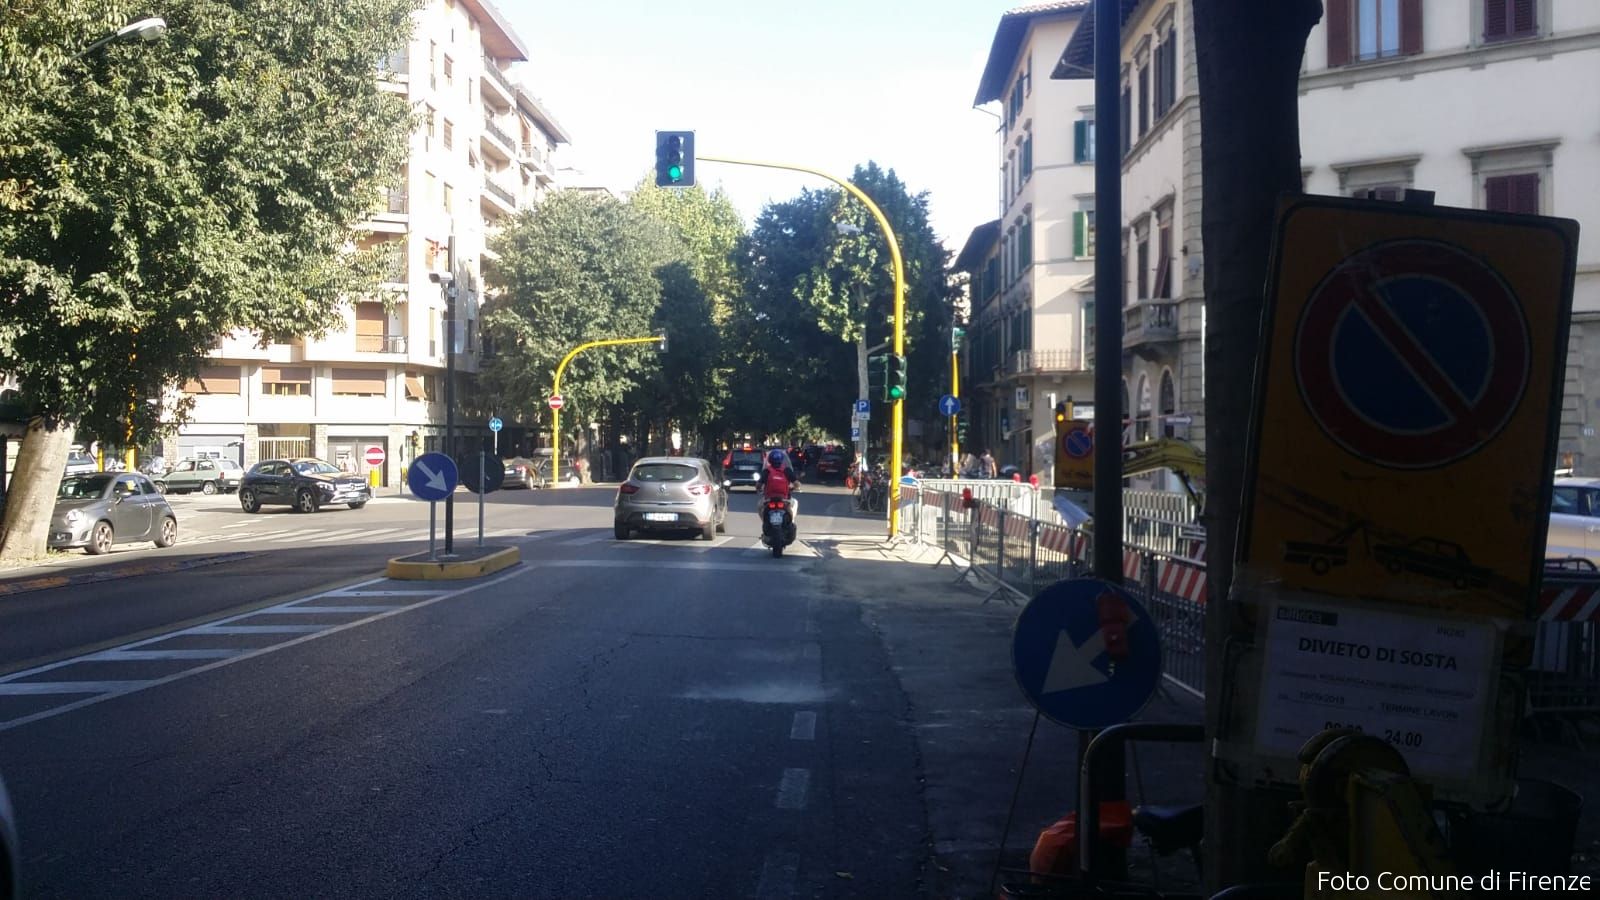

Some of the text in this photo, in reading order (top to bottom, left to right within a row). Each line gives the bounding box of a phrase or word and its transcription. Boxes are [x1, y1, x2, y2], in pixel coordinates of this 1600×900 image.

[859, 401, 867, 411] P
[1298, 637, 1457, 671] DIVIETO DI SOSTA
[1380, 702, 1422, 716] TERMINE
[1384, 728, 1422, 748] 24.00
